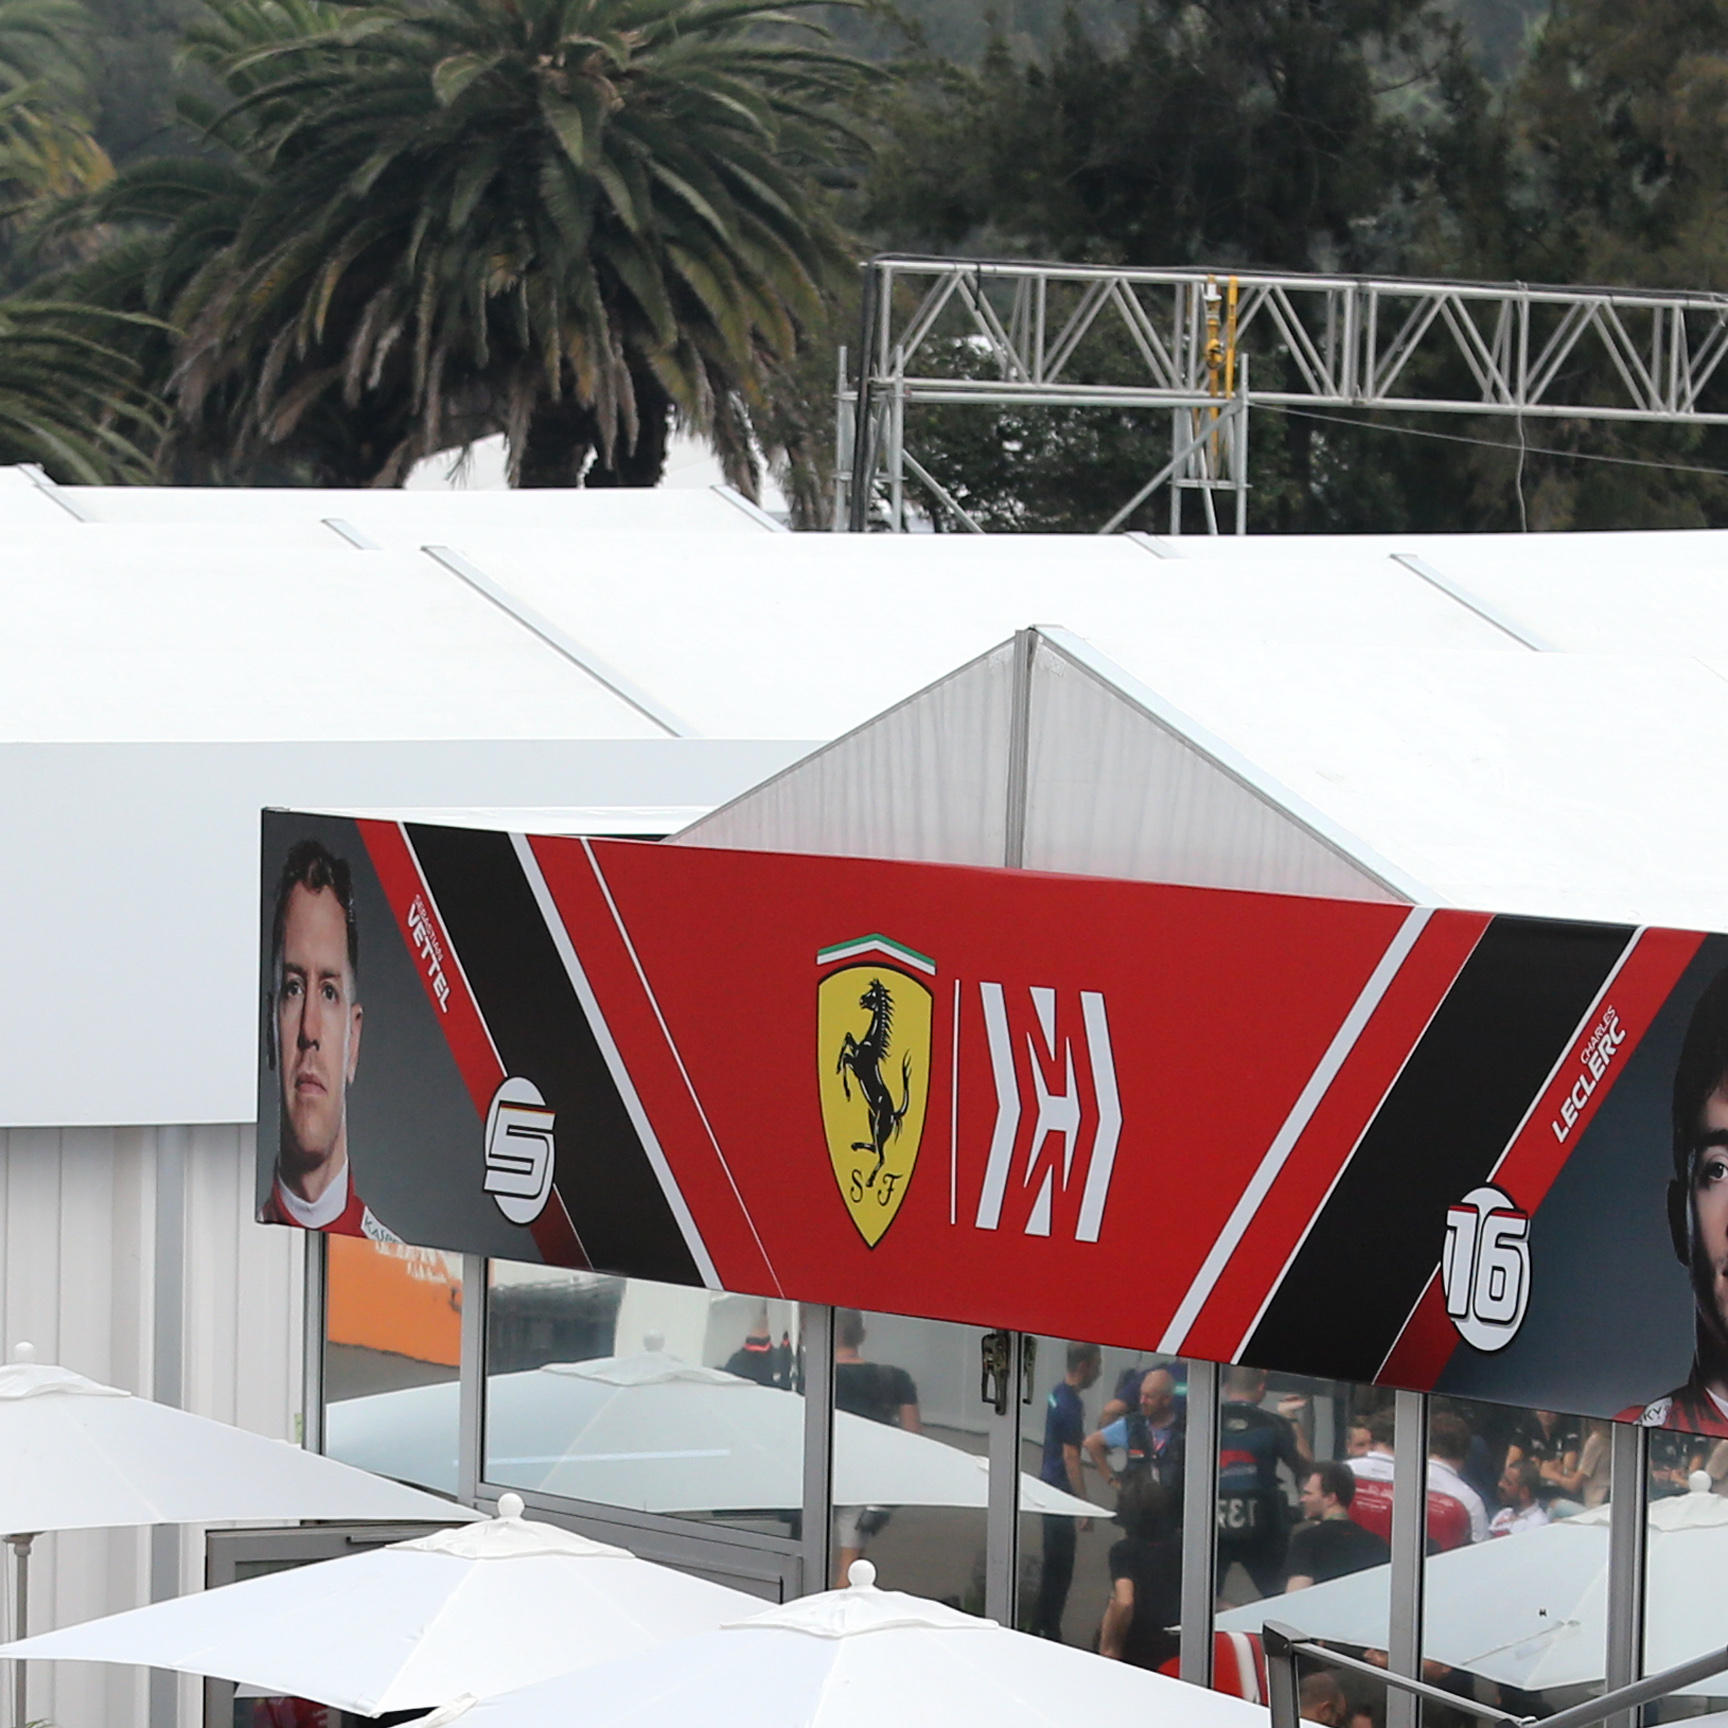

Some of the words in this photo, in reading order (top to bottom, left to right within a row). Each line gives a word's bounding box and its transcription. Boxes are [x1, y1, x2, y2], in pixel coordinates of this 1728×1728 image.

[408, 903, 450, 1013] VETTEL
[1552, 1015, 1626, 1143] LECLERC
[1581, 1005, 1616, 1064] CHARLES
[482, 1103, 556, 1200] 5
[1445, 1202, 1531, 1325] 16
